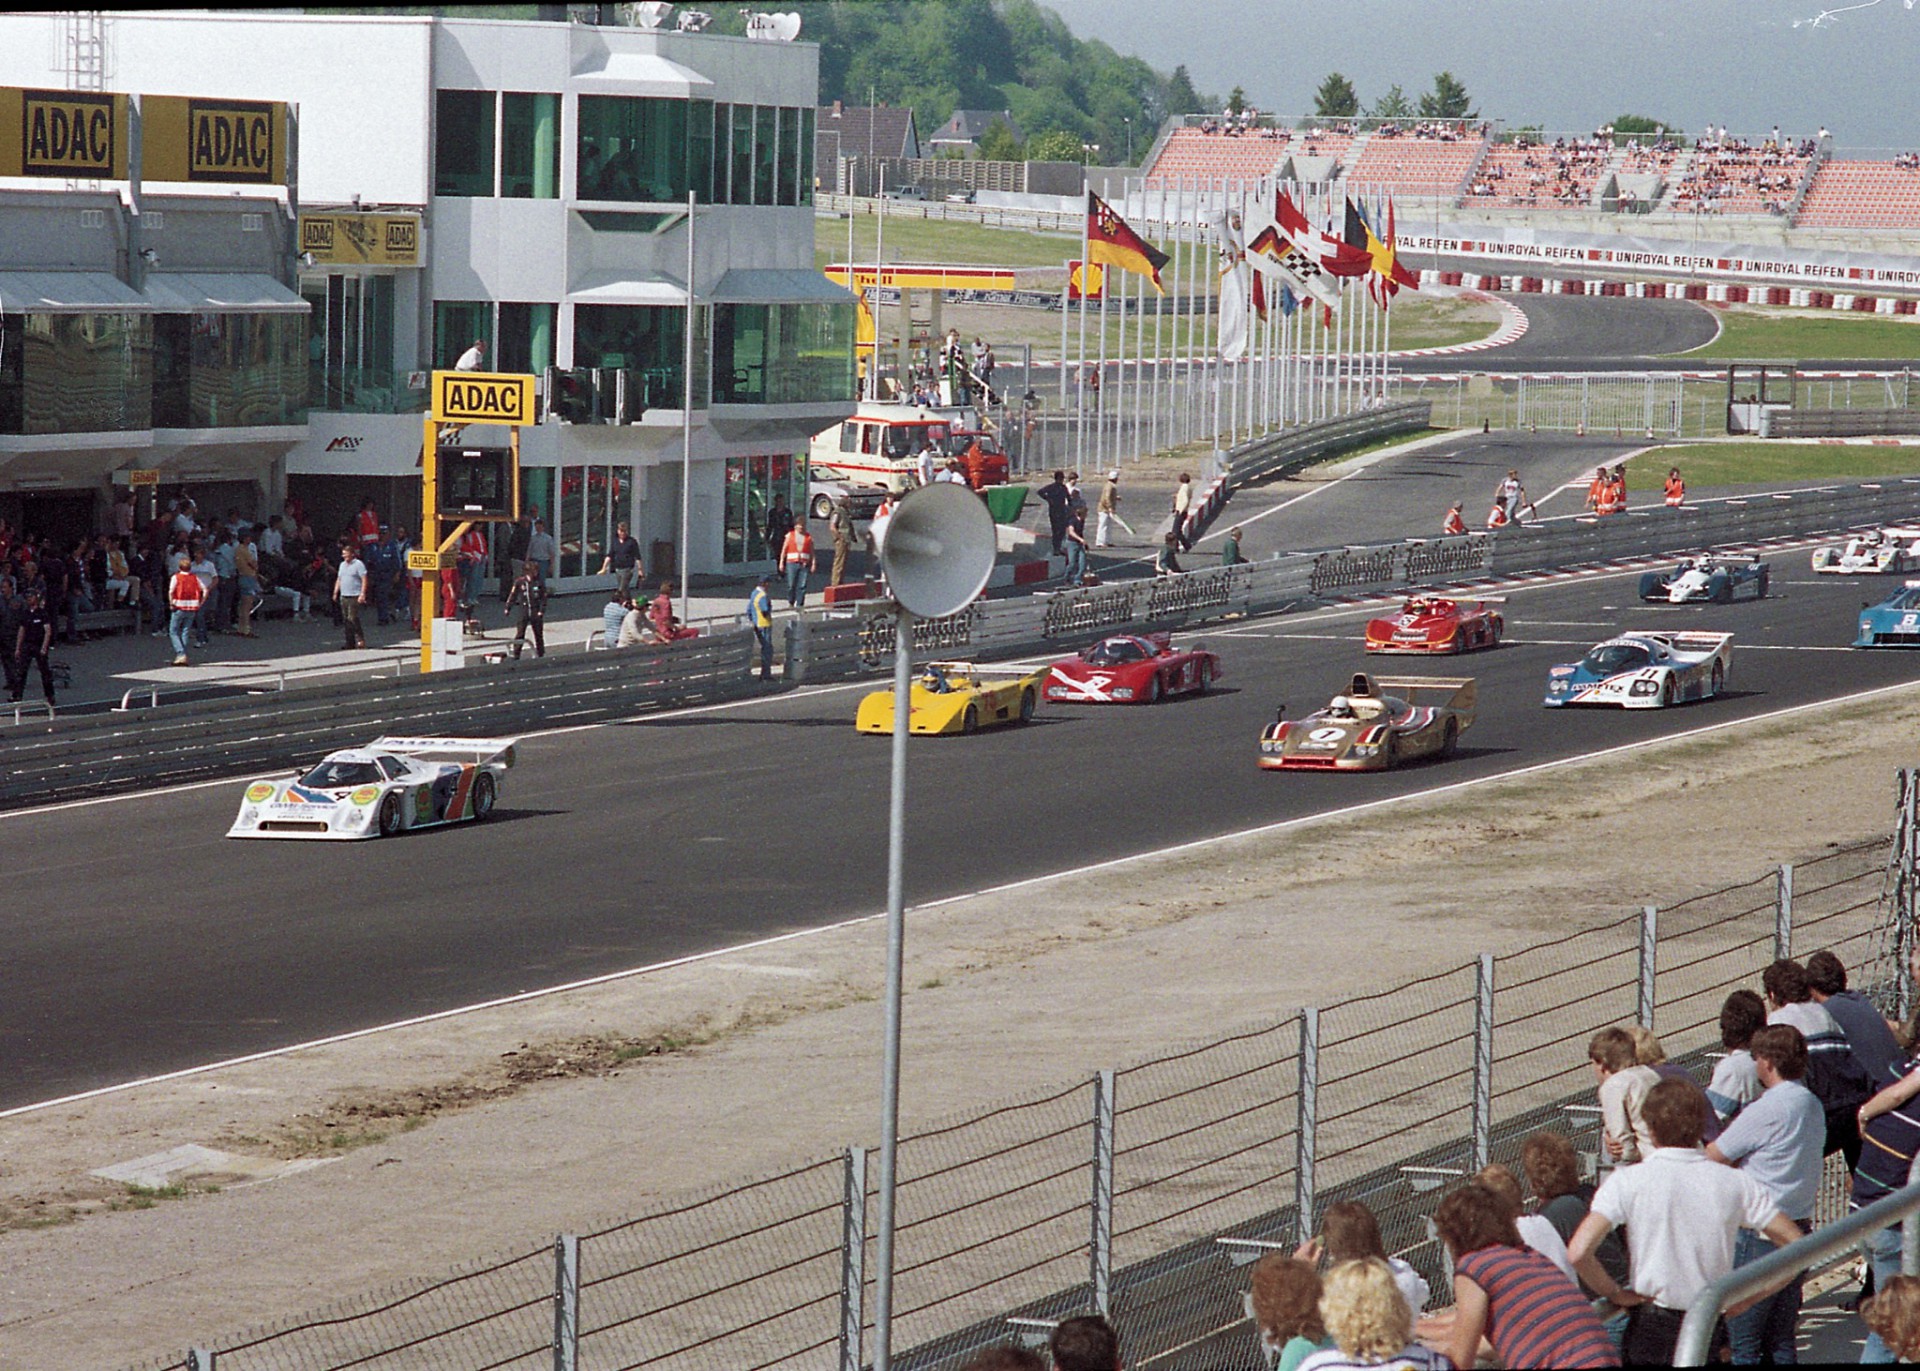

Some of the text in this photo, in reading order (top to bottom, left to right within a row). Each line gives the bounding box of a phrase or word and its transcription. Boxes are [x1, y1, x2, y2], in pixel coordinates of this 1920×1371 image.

[30, 106, 107, 162] ADAC
[195, 115, 267, 168] ADAC
[306, 223, 332, 244] ADAC
[389, 225, 413, 245] ADAC
[1419, 238, 1458, 250] REIFEN
[1488, 243, 1584, 259] UNIROYAL REIFEN
[1616, 251, 1713, 268] UNIROYAL REIFEN
[1746, 261, 1845, 278] UNIROYAL REIFEN
[855, 275, 892, 285] hell
[449, 384, 517, 413] ADAC
[411, 555, 435, 567] ADAC
[1641, 668, 1659, 680] 11
[1320, 730, 1336, 740] 1
